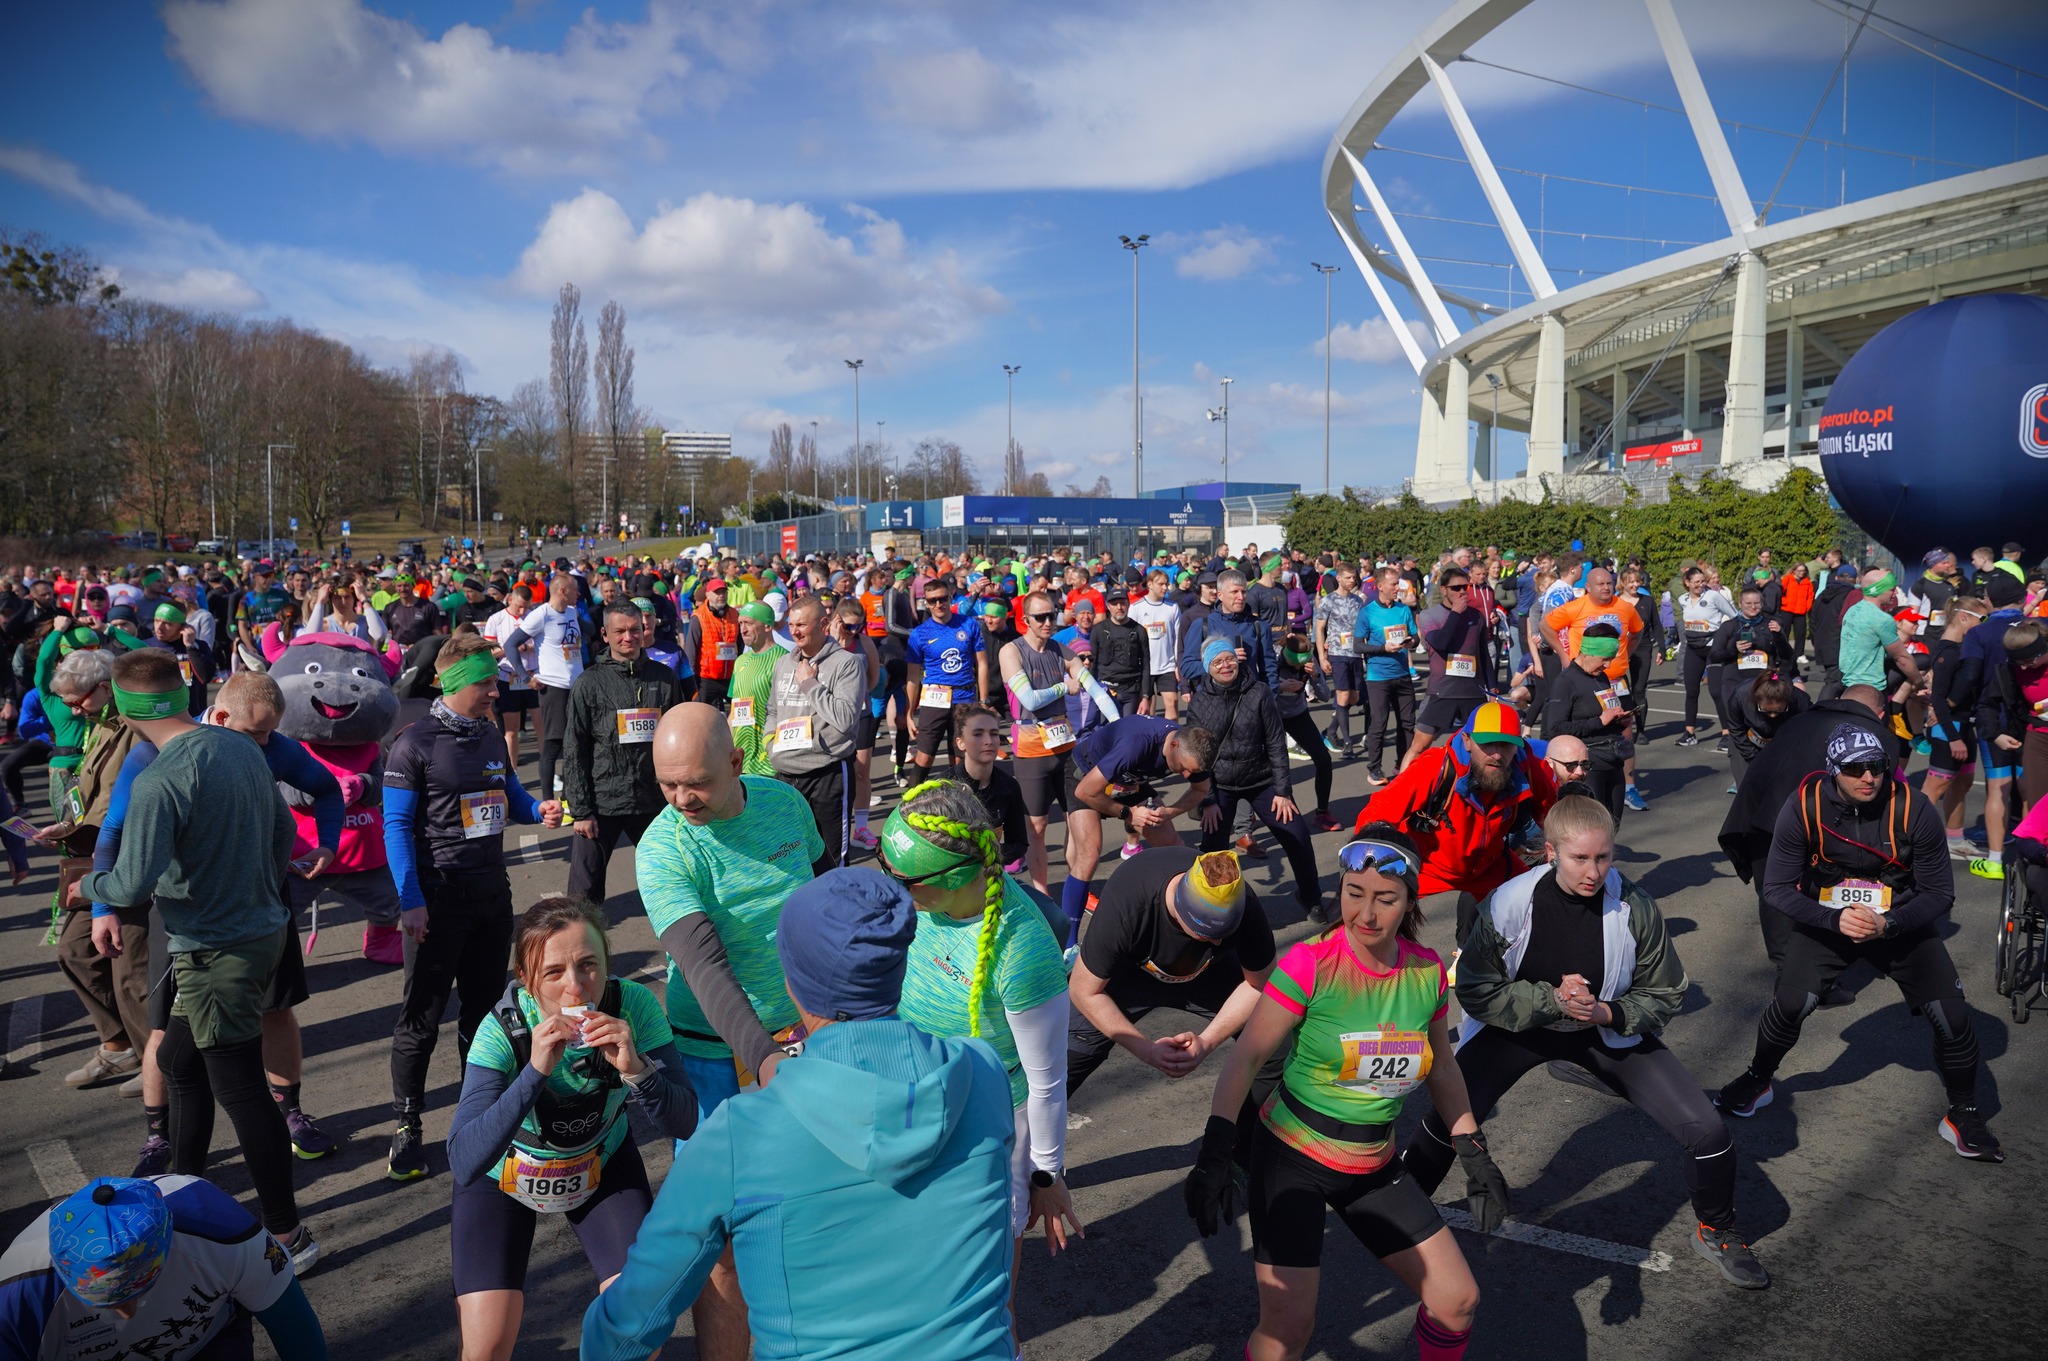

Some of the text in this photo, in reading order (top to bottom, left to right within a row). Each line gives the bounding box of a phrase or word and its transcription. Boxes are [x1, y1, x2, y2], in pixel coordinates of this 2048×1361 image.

[1671, 443, 1691, 454] TYSKIE
[1844, 430, 1893, 458] ŚLĄSKI
[903, 506, 912, 527] 1
[974, 515, 993, 523] WEJŚCIE
[1038, 515, 1058, 524] WEJŚCIE
[1099, 516, 1118, 524] WEJŚCIE
[941, 648, 962, 673] 3
[1456, 661, 1470, 670] 363
[930, 692, 943, 700] 417
[737, 708, 748, 717] 610
[630, 720, 655, 731] 1588
[783, 728, 800, 740] 227
[343, 812, 375, 827] RON
[480, 805, 501, 821] 279
[1841, 888, 1873, 903] 895
[1358, 1040, 1425, 1055] BIEG WIOSENNY
[1369, 1056, 1410, 1079] 242
[516, 1157, 596, 1178] BIEG WIOSENNY
[524, 1175, 583, 1196] 1963
[70, 1313, 101, 1330] kalas
